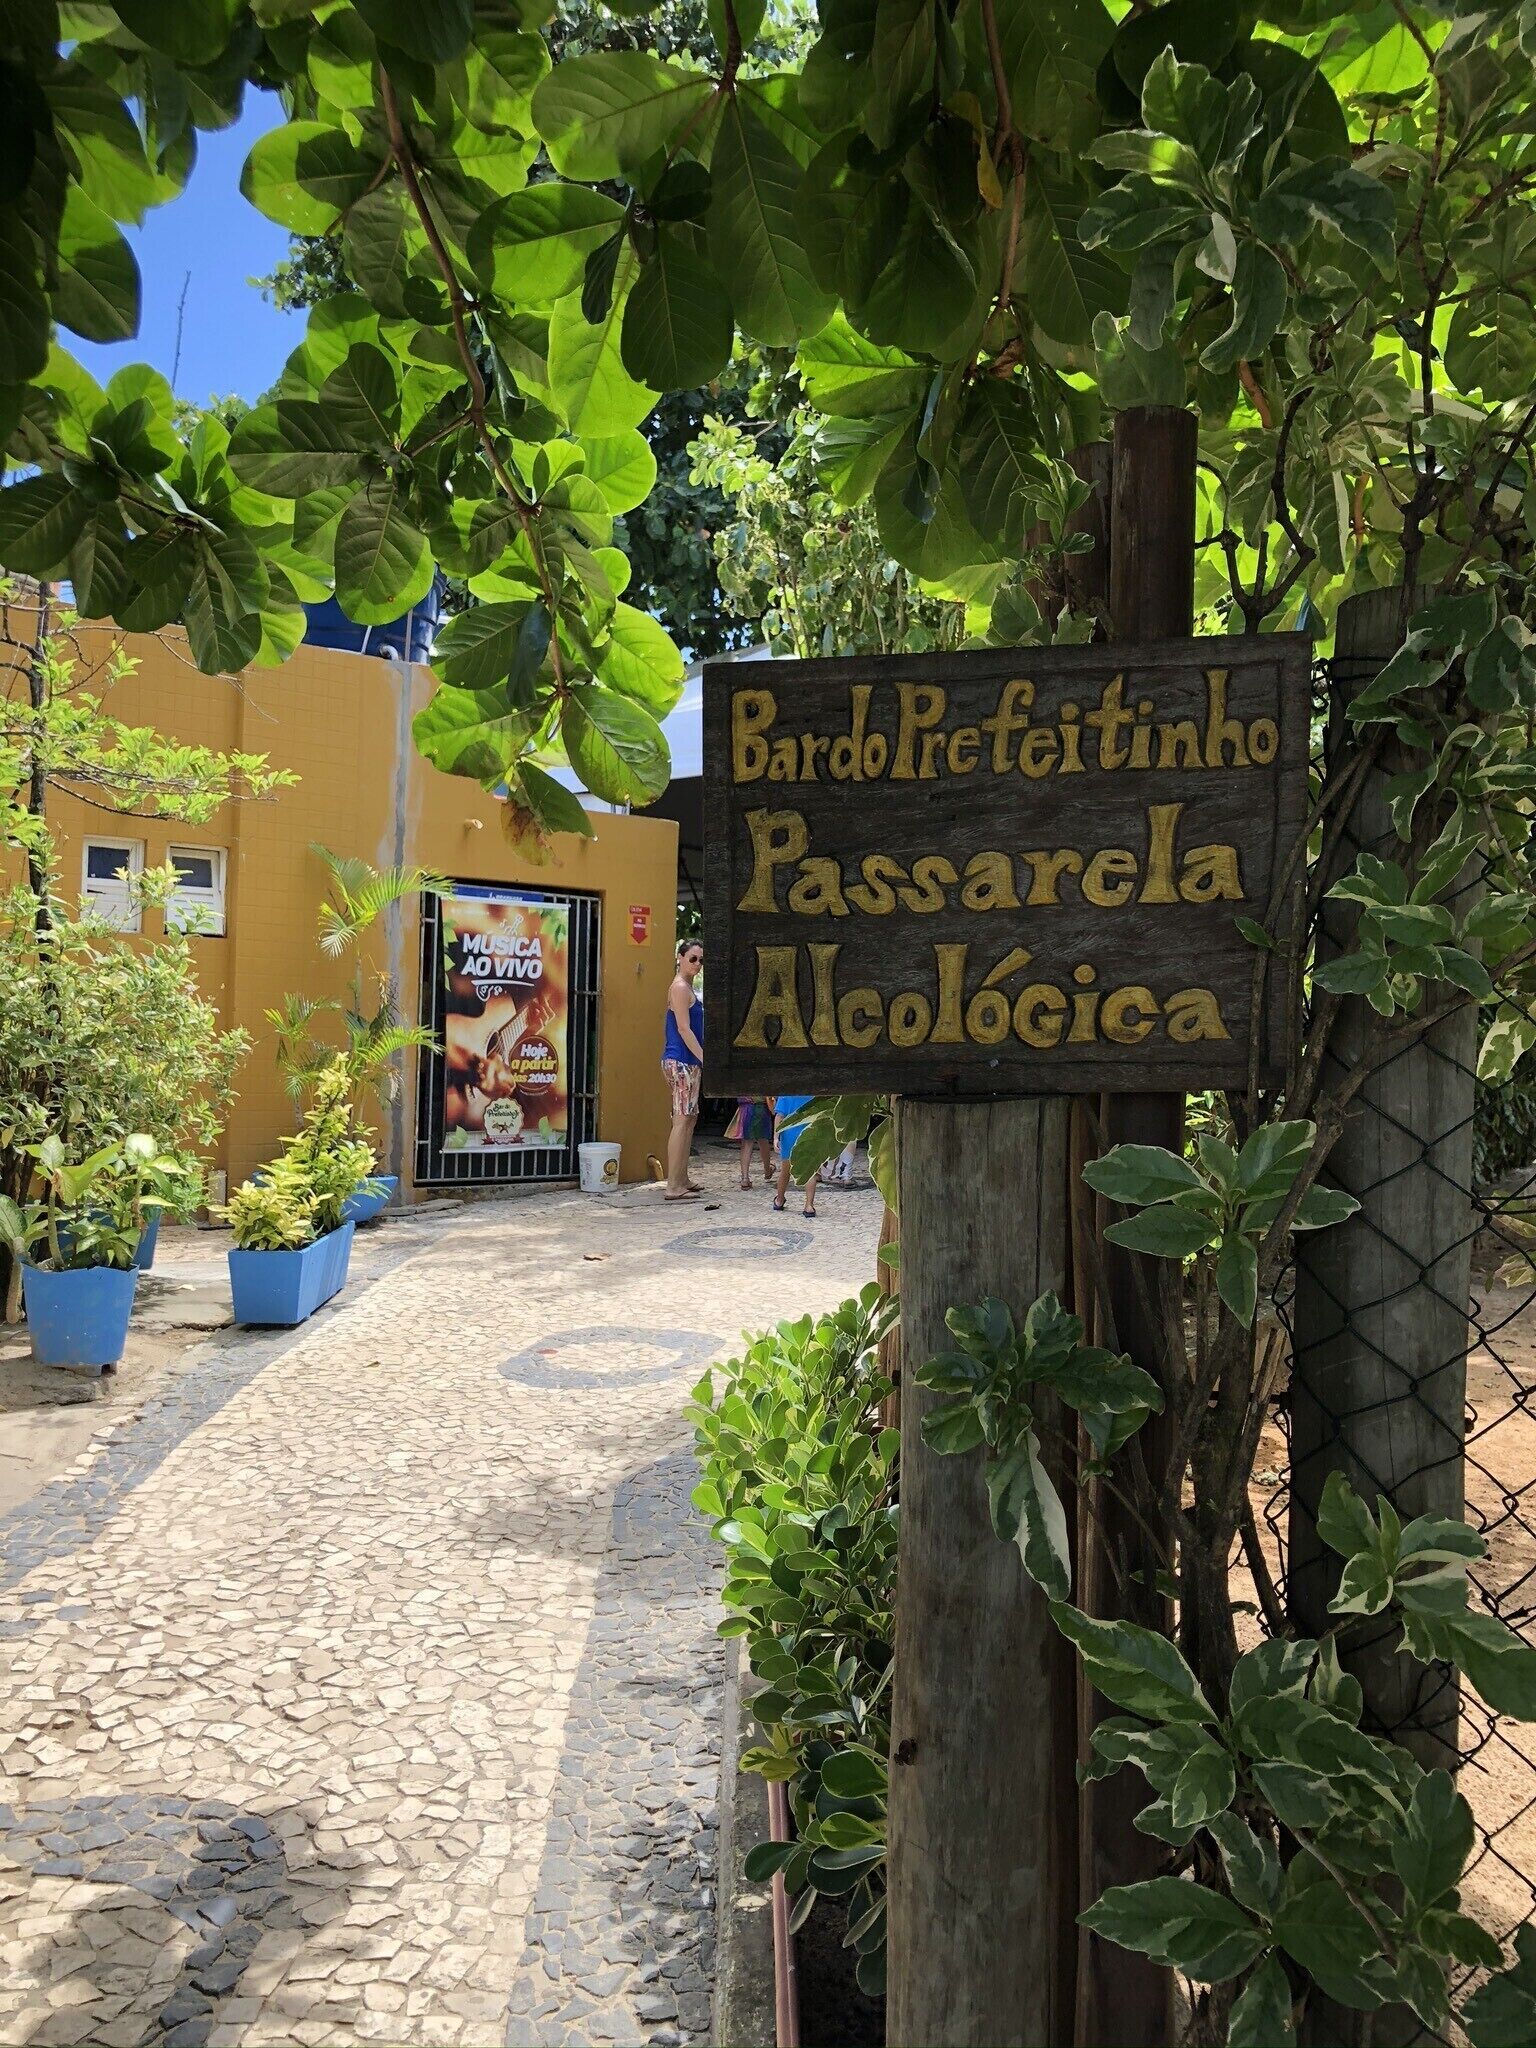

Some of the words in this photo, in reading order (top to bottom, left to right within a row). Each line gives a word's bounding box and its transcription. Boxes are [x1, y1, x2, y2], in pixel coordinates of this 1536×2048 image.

[736, 803, 1244, 917] Passarela
[460, 955, 492, 977] AO
[494, 957, 543, 979] VIVO
[520, 1043, 548, 1060] Hoje
[520, 1056, 557, 1073] partir
[528, 1073, 557, 1084] 20h30
